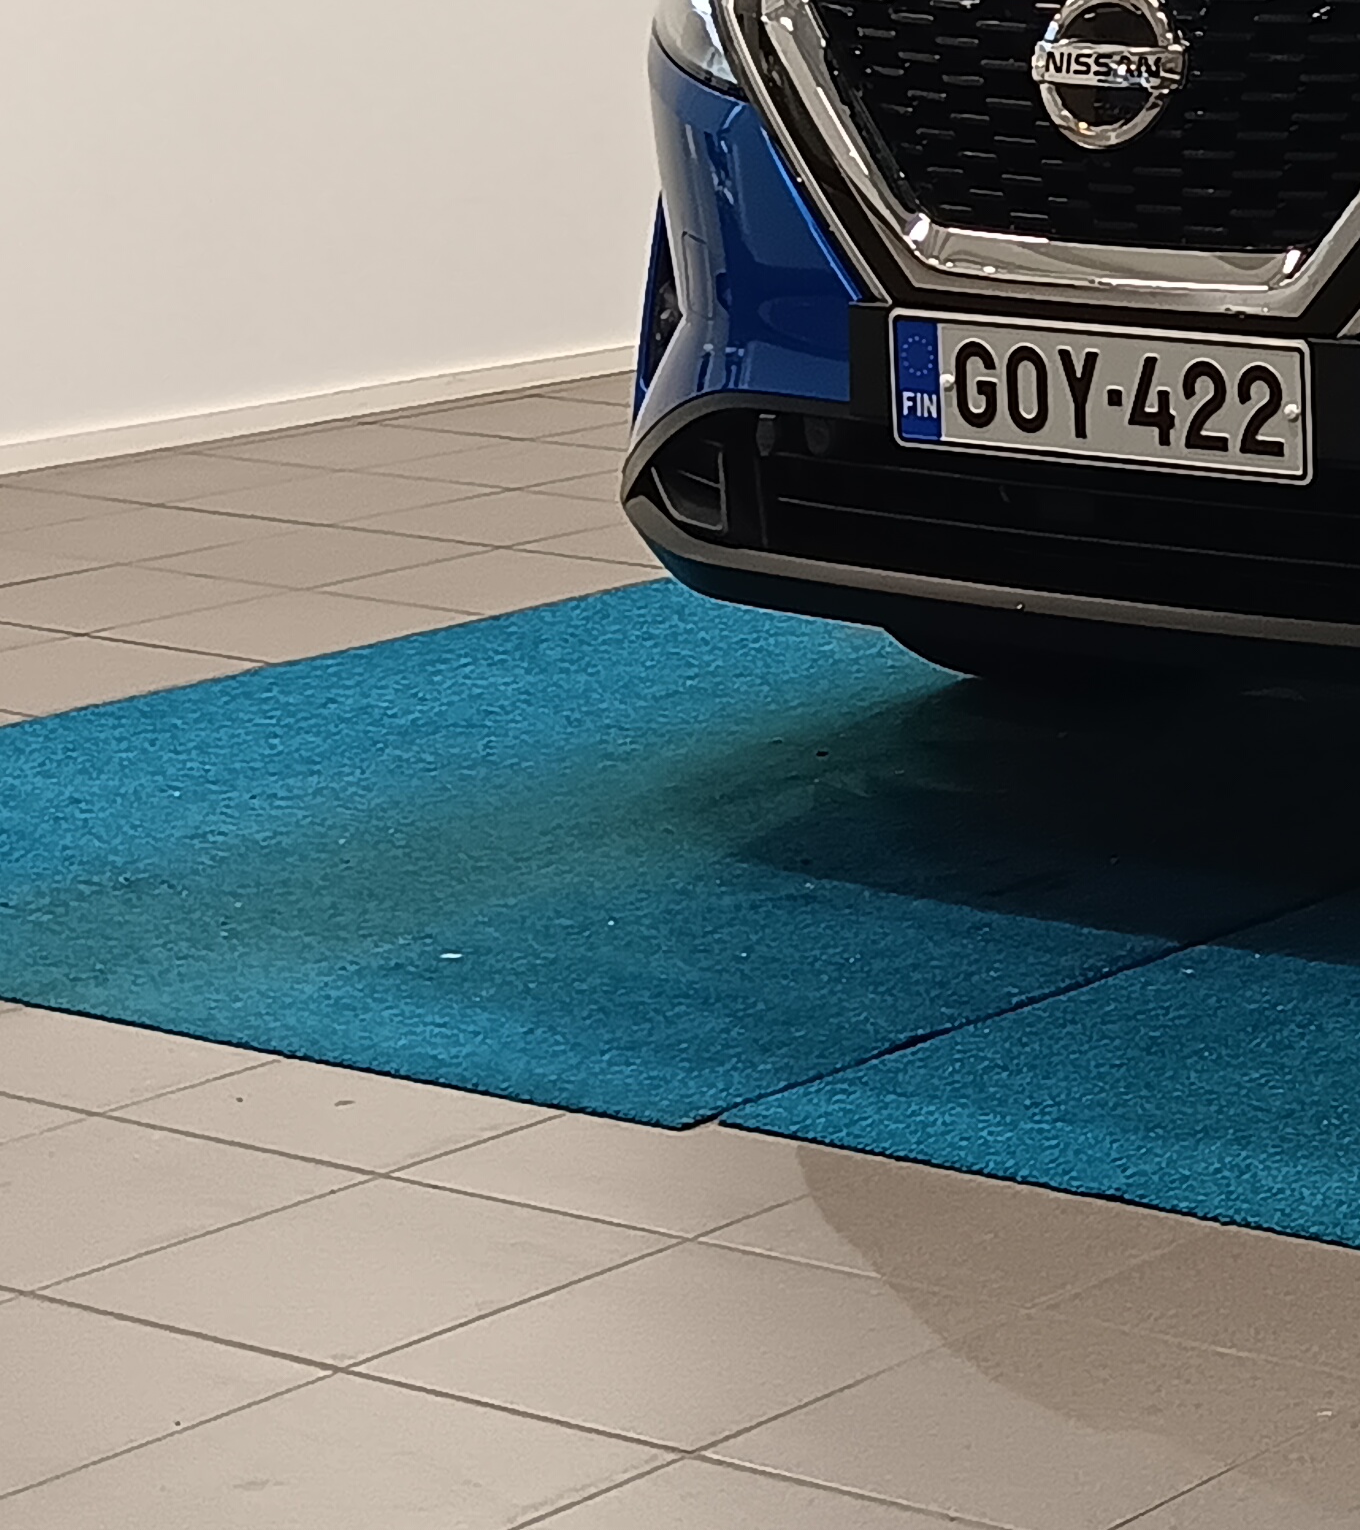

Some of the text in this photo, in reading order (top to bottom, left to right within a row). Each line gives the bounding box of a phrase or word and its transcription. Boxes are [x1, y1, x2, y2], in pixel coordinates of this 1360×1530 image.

[1045, 51, 1162, 78] NISSAN
[901, 391, 938, 419] FIN
[954, 338, 1286, 458] GOY-422
